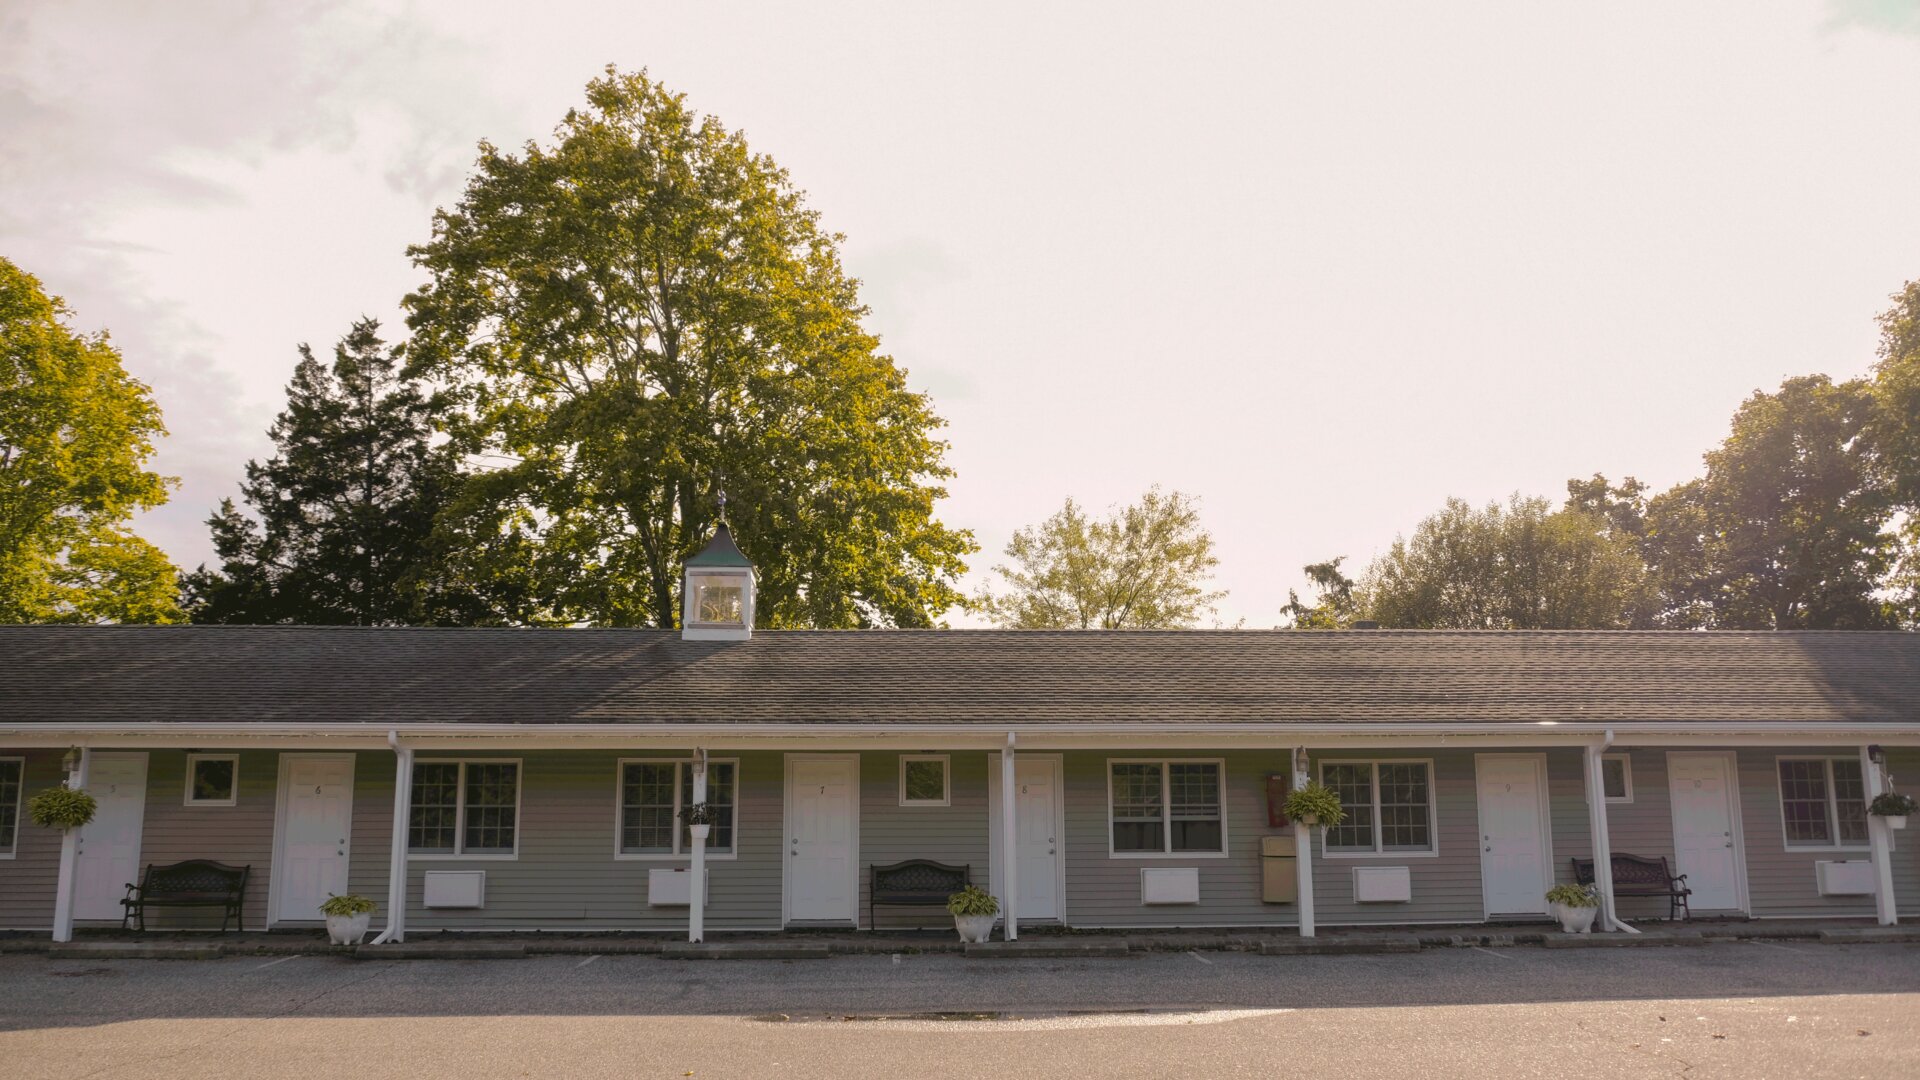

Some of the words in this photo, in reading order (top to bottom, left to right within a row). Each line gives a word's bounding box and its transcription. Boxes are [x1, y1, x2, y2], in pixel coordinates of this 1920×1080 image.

[315, 785, 321, 795] 6
[820, 785, 825, 795] 7
[1022, 784, 1028, 794] 8
[1505, 783, 1511, 793] 9
